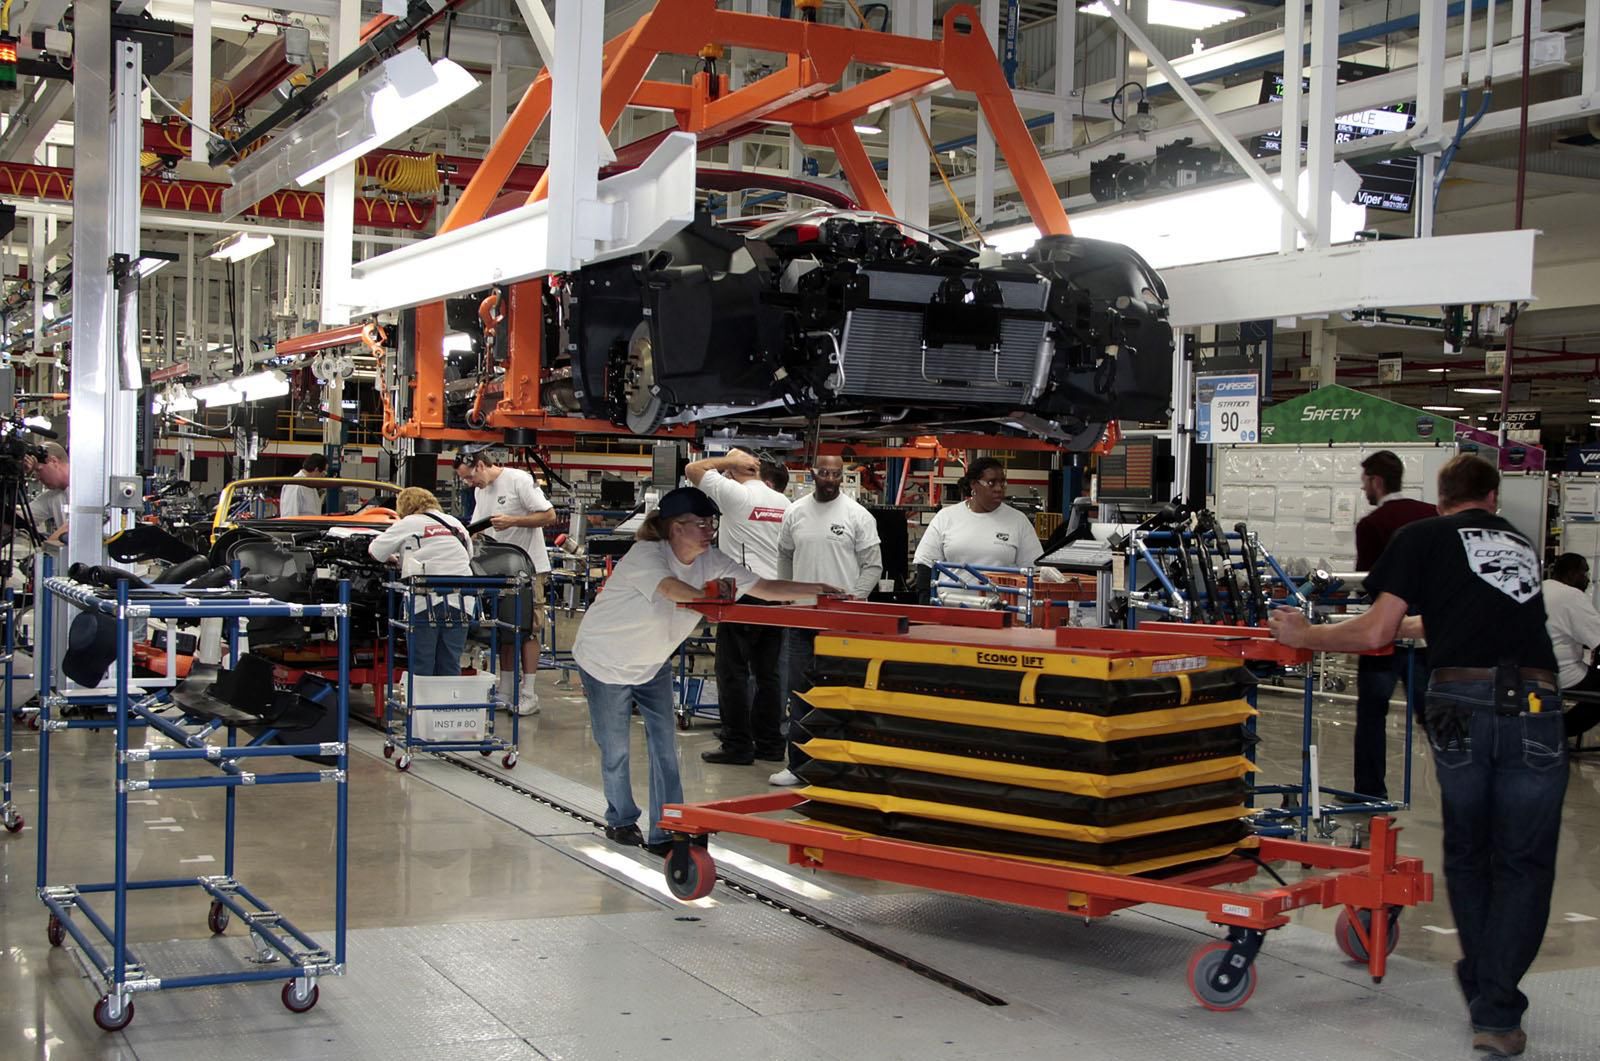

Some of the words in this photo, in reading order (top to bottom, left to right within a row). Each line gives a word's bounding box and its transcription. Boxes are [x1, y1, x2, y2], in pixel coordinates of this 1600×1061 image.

[1358, 191, 1382, 206] Viper
[1217, 400, 1250, 408] STATION
[1301, 405, 1362, 421] SAFETY
[1220, 411, 1239, 432] 90
[976, 652, 1018, 667] ECONO
[1021, 654, 1045, 669] LIFT
[434, 720, 455, 728] INST
